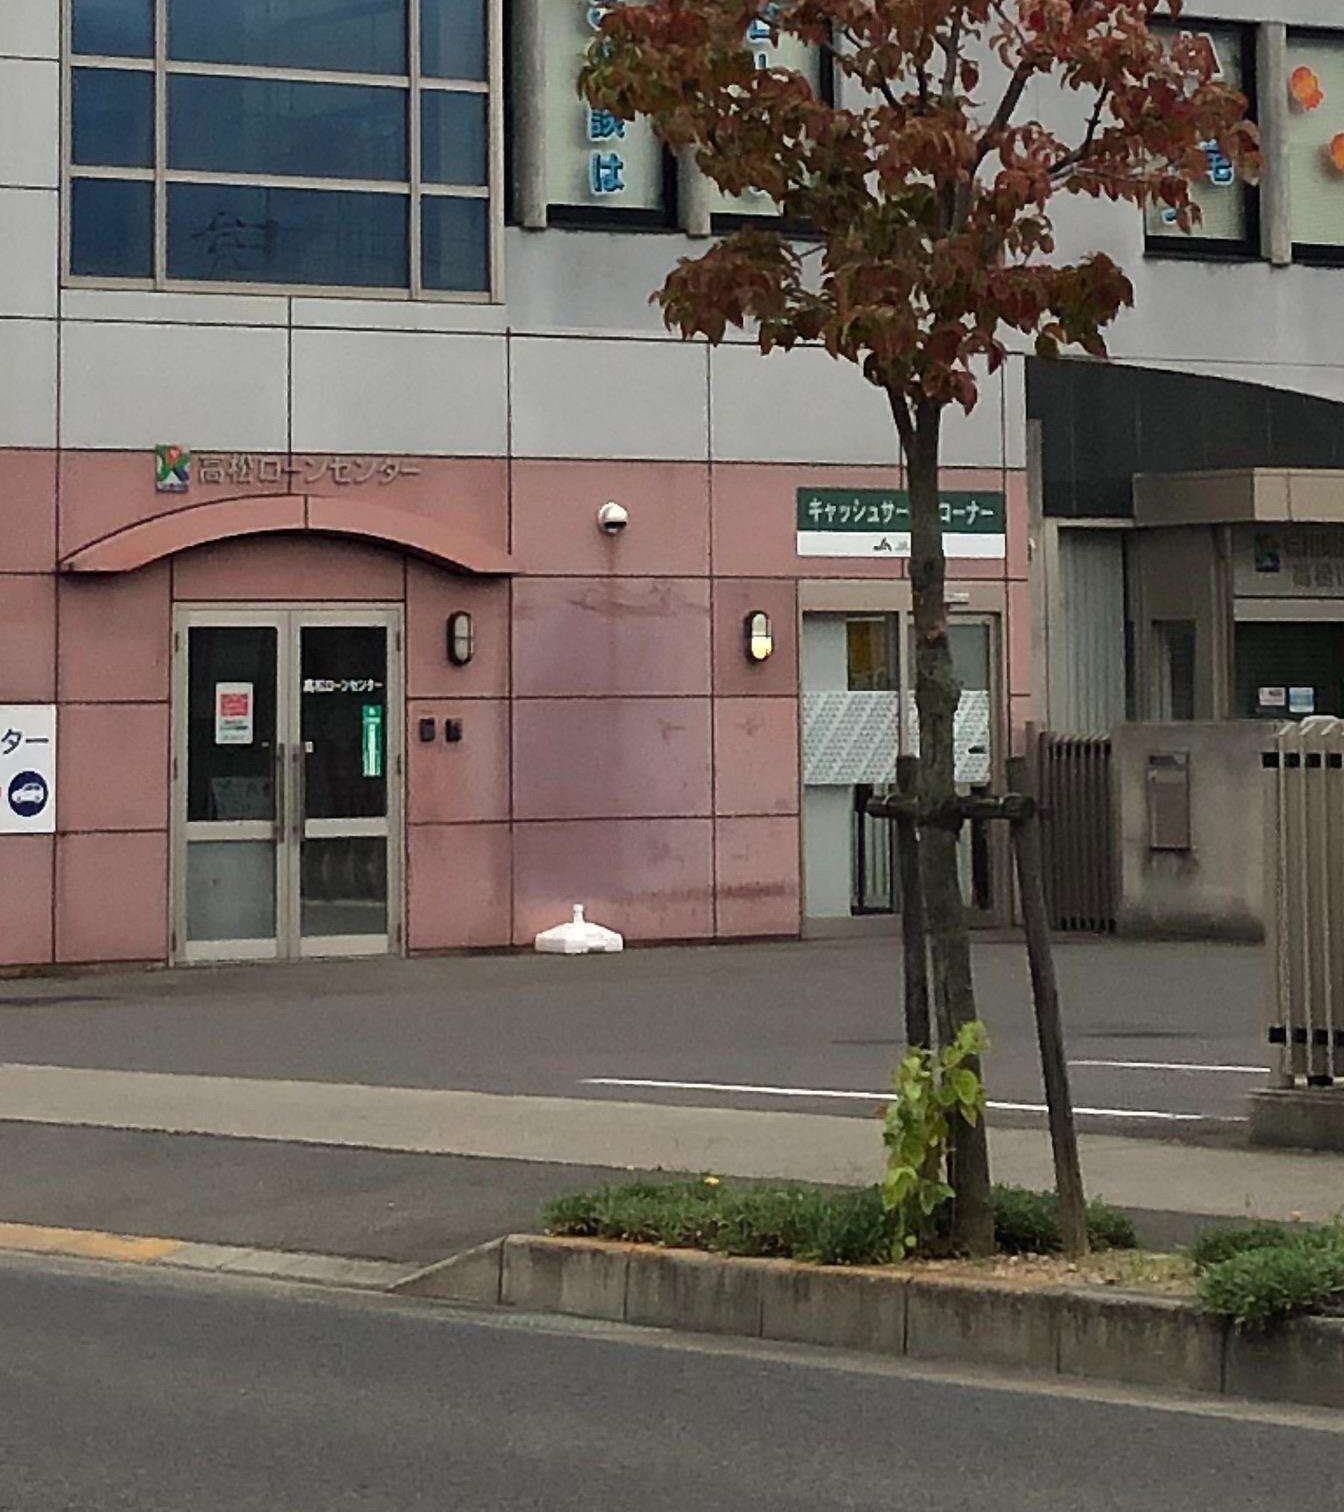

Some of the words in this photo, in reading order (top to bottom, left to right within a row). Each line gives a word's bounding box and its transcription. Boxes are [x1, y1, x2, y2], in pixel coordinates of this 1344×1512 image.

[199, 454, 422, 485] 高松ローンセンター
[808, 497, 994, 525] キャッシュサーコーナー
